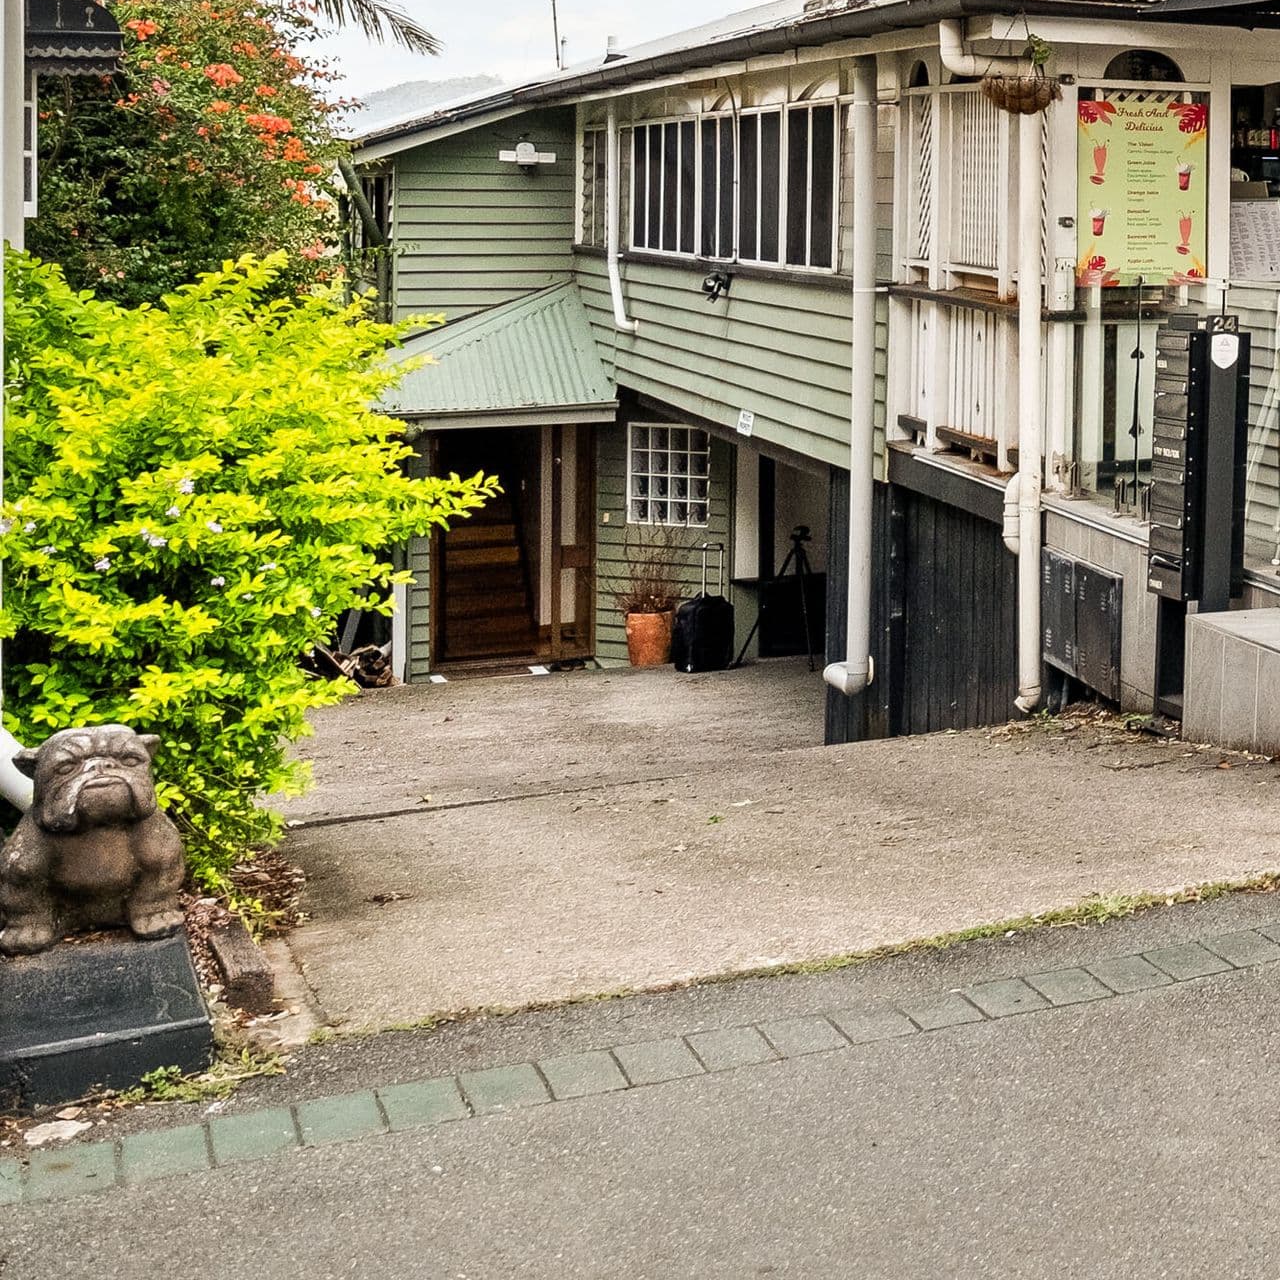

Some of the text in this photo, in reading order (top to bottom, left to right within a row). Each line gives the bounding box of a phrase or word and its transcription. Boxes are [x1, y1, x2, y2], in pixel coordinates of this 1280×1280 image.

[1116, 107, 1169, 118] Fresh And
[1213, 316, 1236, 332] 24
